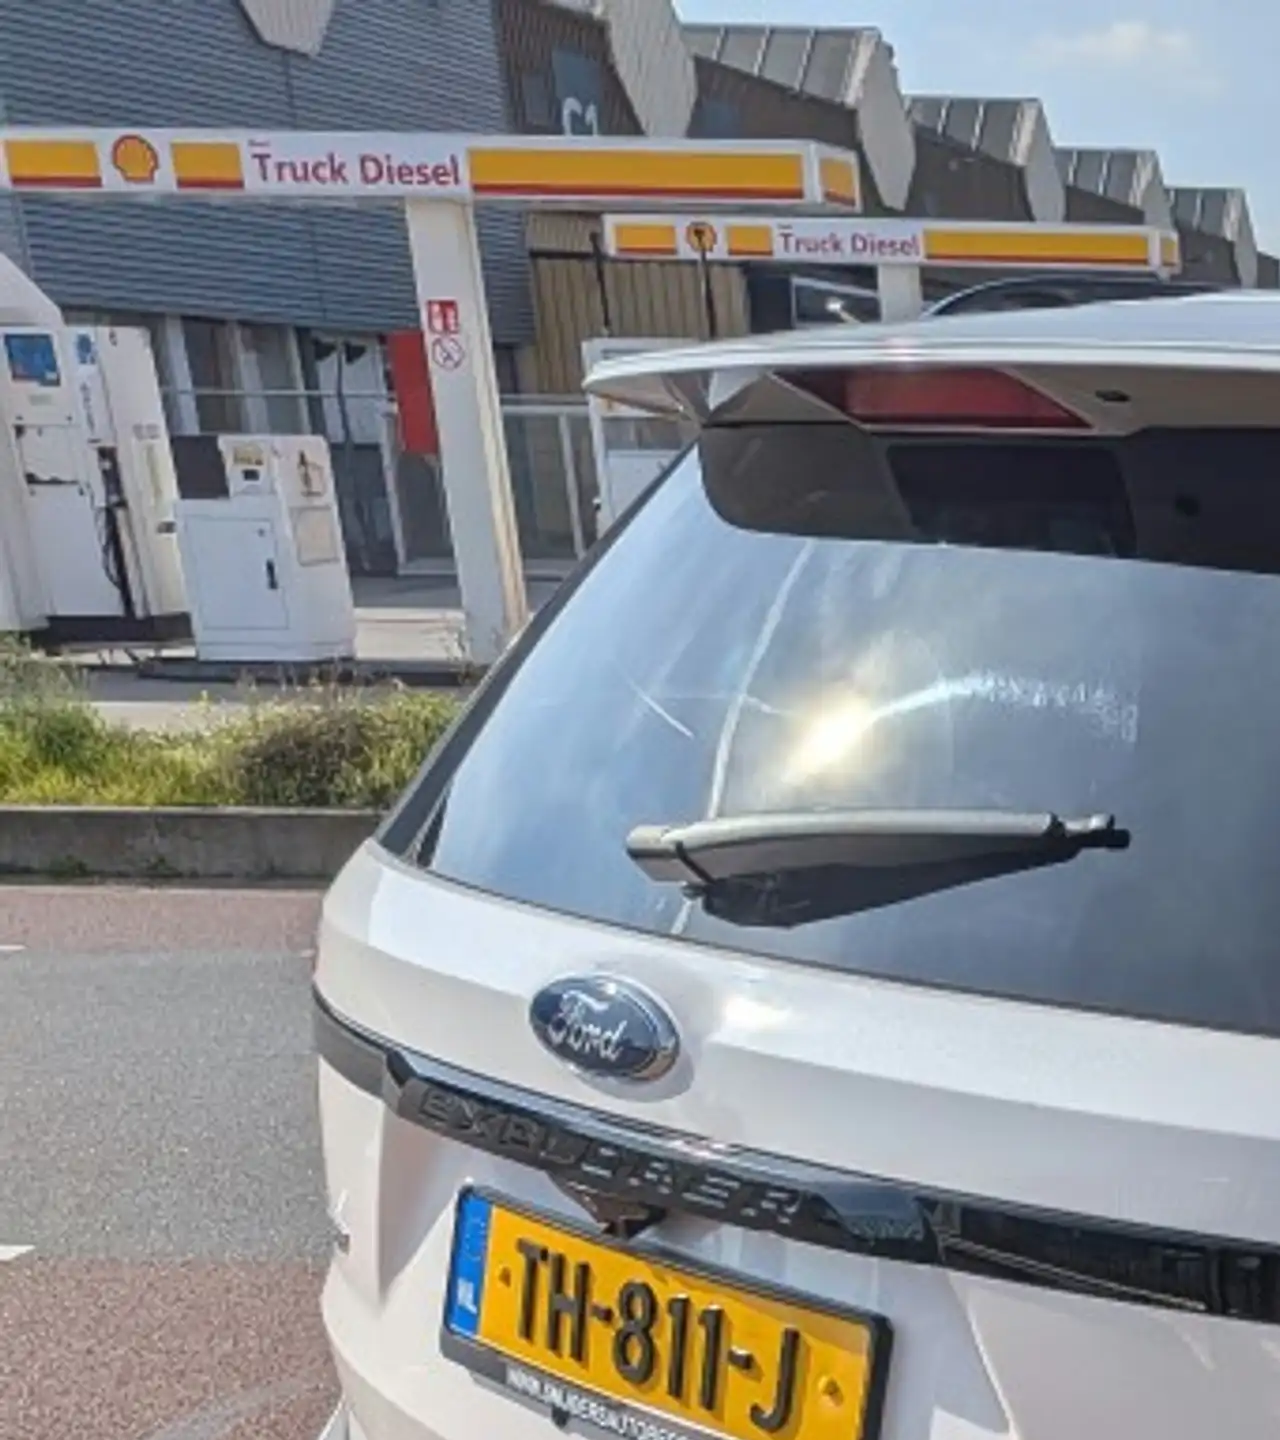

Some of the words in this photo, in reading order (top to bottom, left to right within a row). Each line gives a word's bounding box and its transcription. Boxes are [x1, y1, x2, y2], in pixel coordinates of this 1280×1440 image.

[251, 153, 348, 184] Truck
[359, 153, 459, 185] Diesel
[780, 232, 842, 253] Truck
[852, 233, 921, 256] Diesel
[549, 988, 628, 1062] Ford
[419, 1088, 800, 1225] EXPLORER
[517, 1238, 800, 1433] TH-811-J
